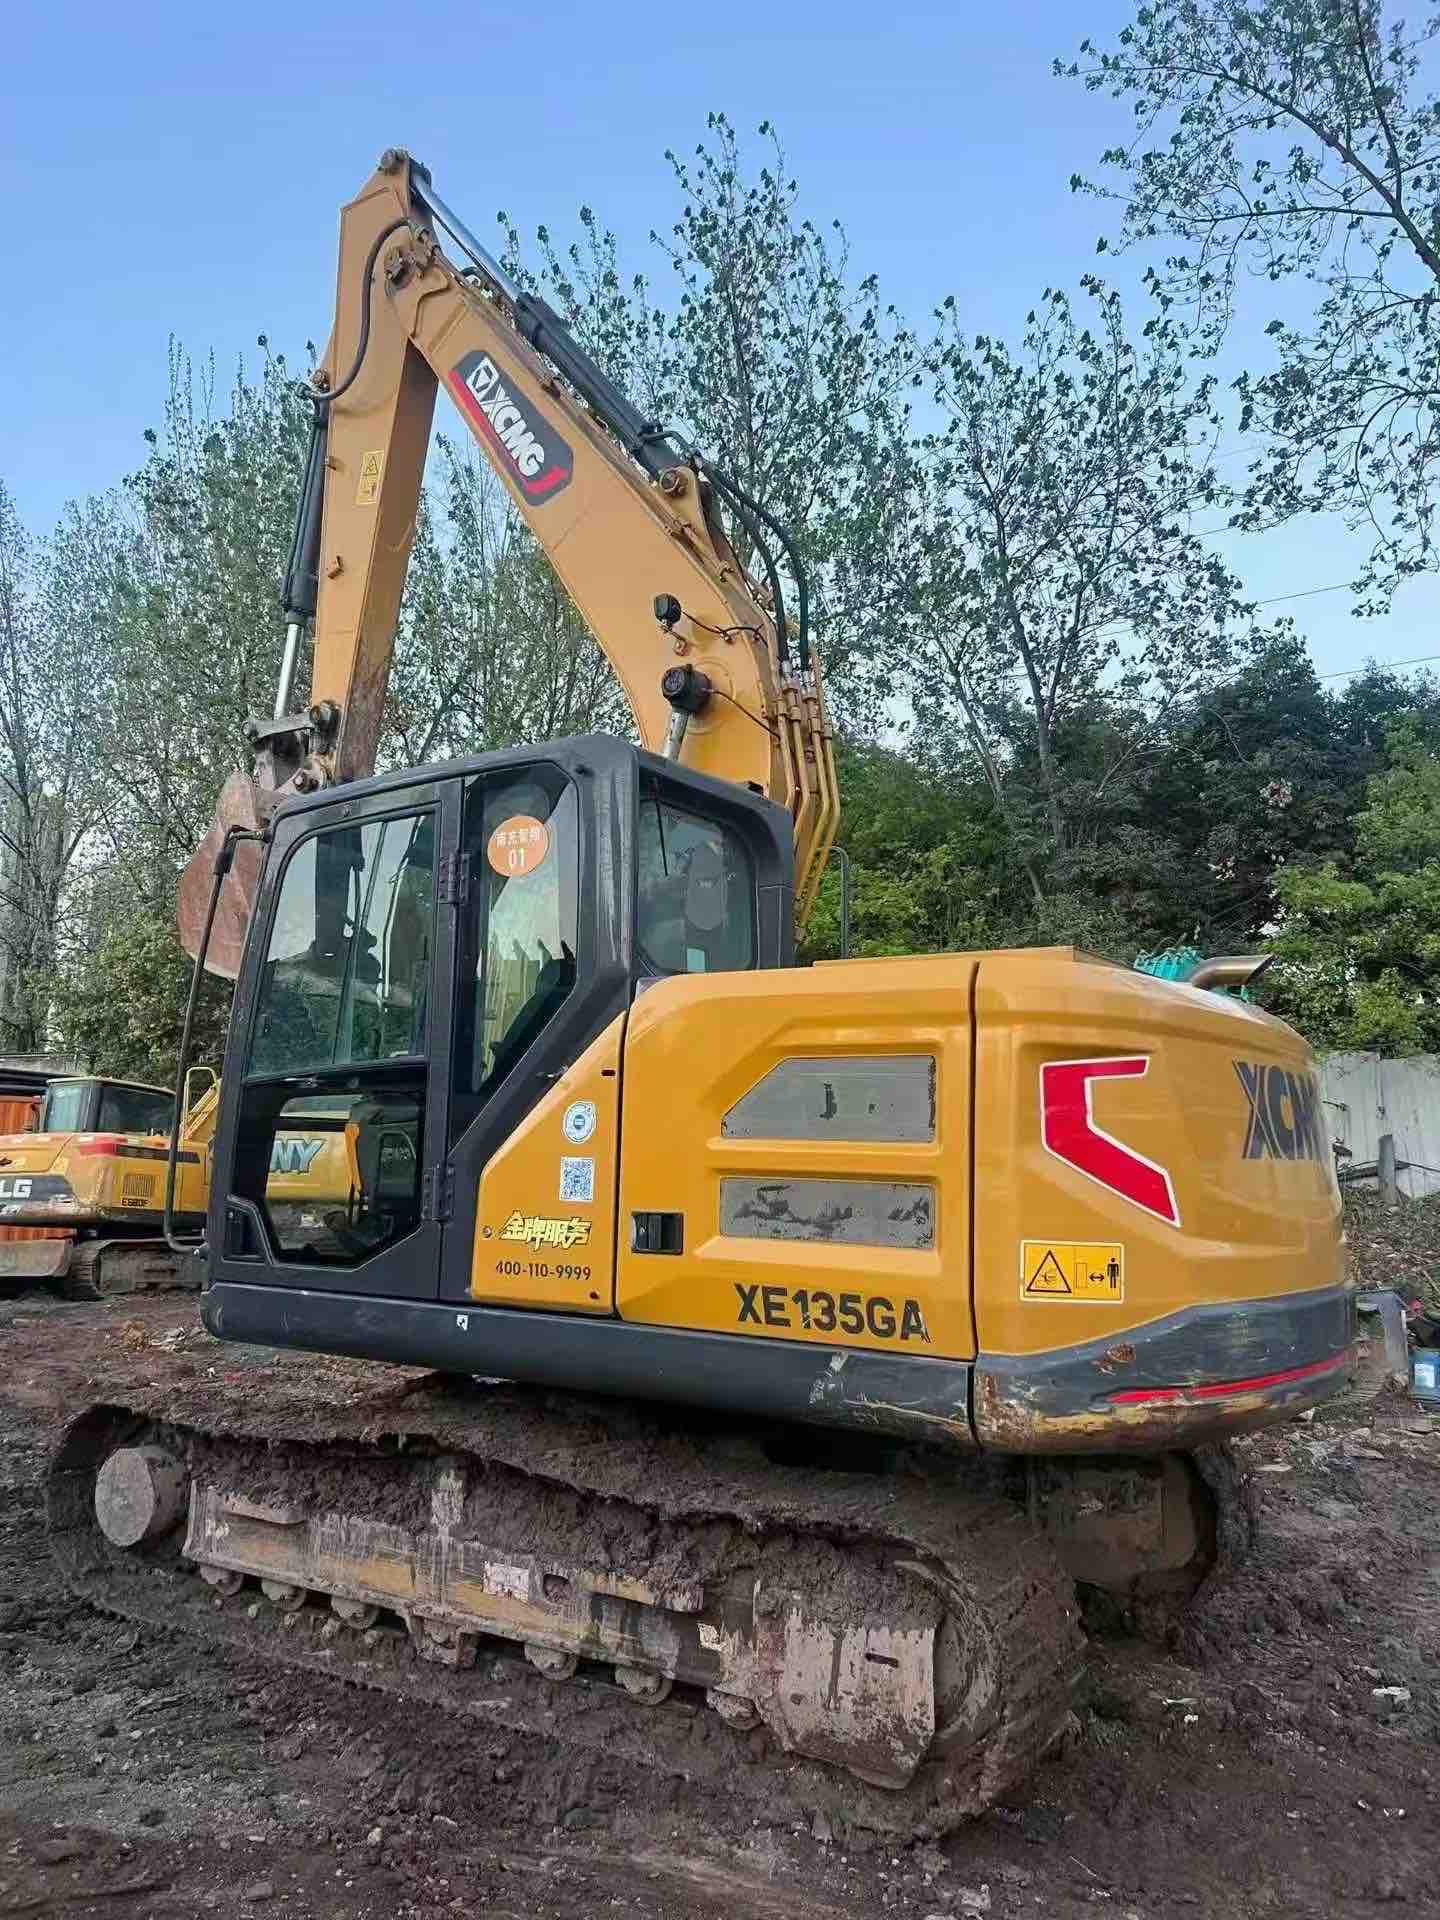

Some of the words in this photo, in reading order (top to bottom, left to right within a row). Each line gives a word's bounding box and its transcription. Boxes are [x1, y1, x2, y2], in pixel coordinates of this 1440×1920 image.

[479, 384, 545, 477] XCMG
[500, 1210, 592, 1251] 金牌服务
[496, 1260, 591, 1280] 400-110-9999
[733, 1283, 931, 1343] XE135GA
